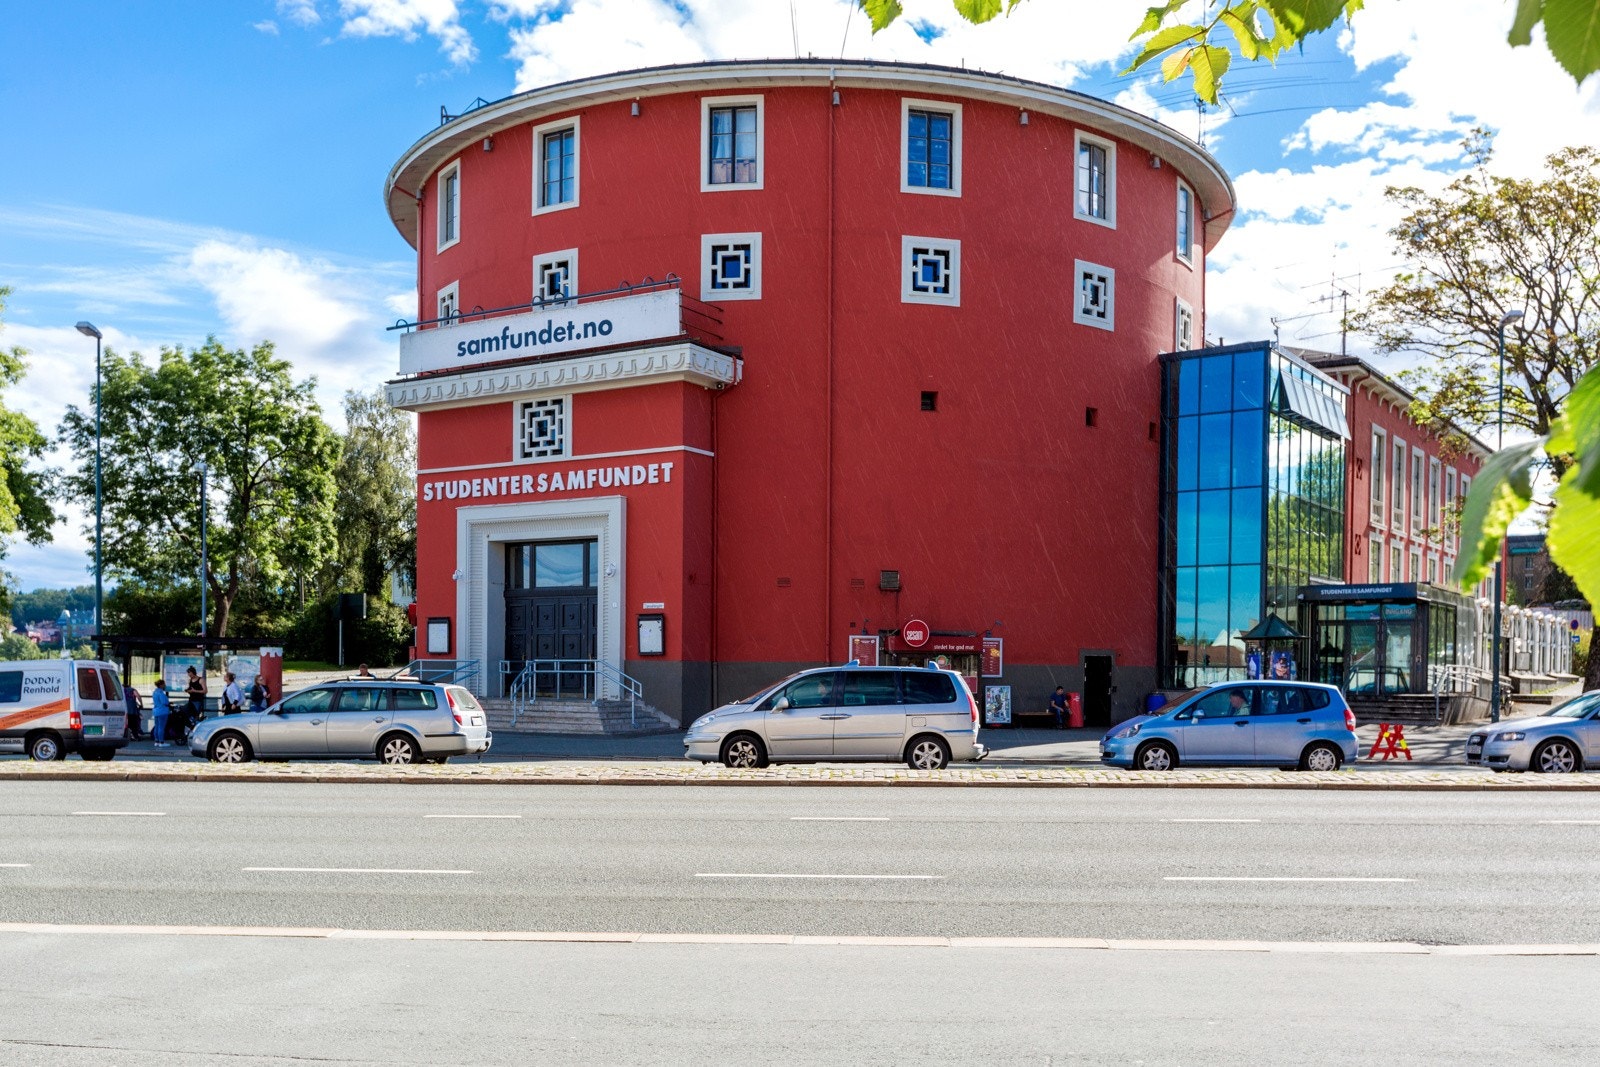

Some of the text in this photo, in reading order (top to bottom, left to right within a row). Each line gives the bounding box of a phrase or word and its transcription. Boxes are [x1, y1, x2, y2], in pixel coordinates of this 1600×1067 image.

[457, 319, 613, 357] samfundet.no
[423, 462, 674, 502] STUDENTERSAMFUNDET
[23, 686, 60, 694] Renhold
